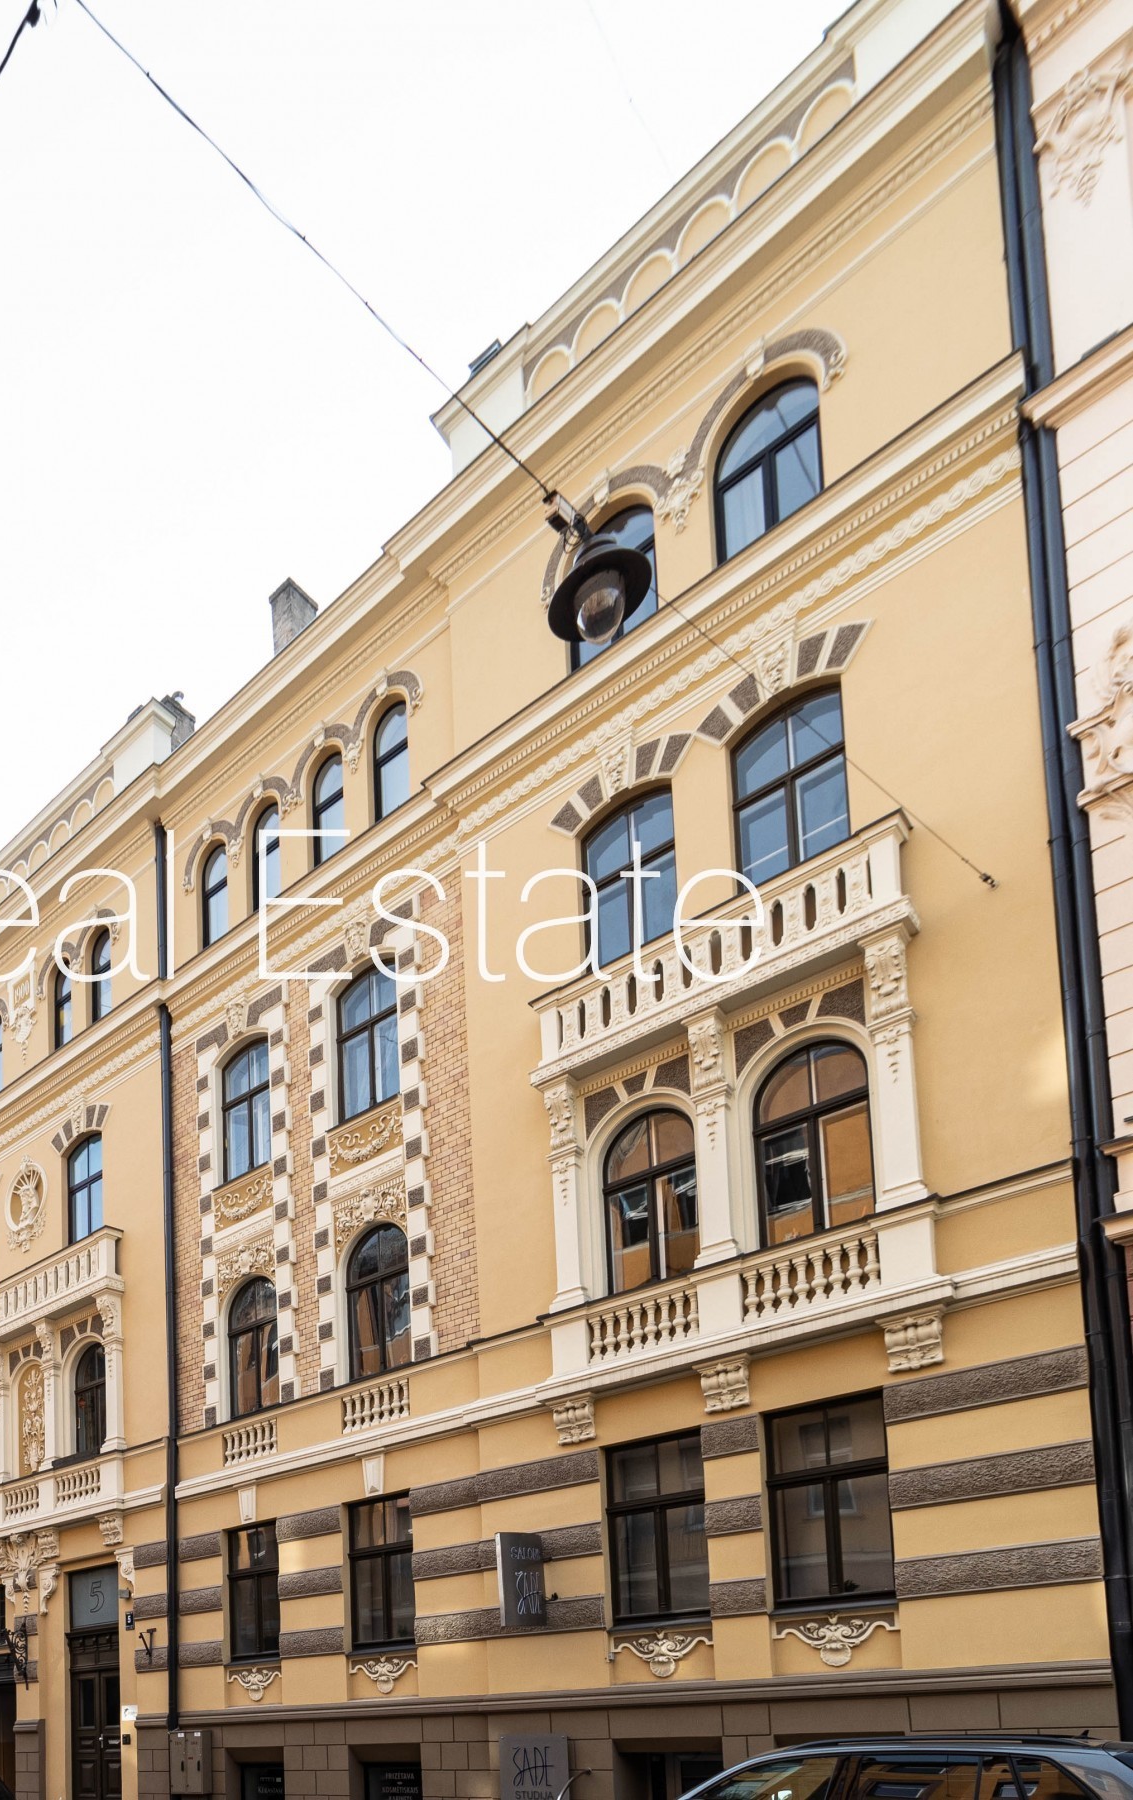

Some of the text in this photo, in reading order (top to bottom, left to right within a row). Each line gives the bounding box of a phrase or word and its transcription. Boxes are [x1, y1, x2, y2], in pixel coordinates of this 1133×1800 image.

[14, 980, 30, 1003] 1900
[89, 1579, 105, 1614] 5
[514, 1790, 554, 1800] STUDIJA
